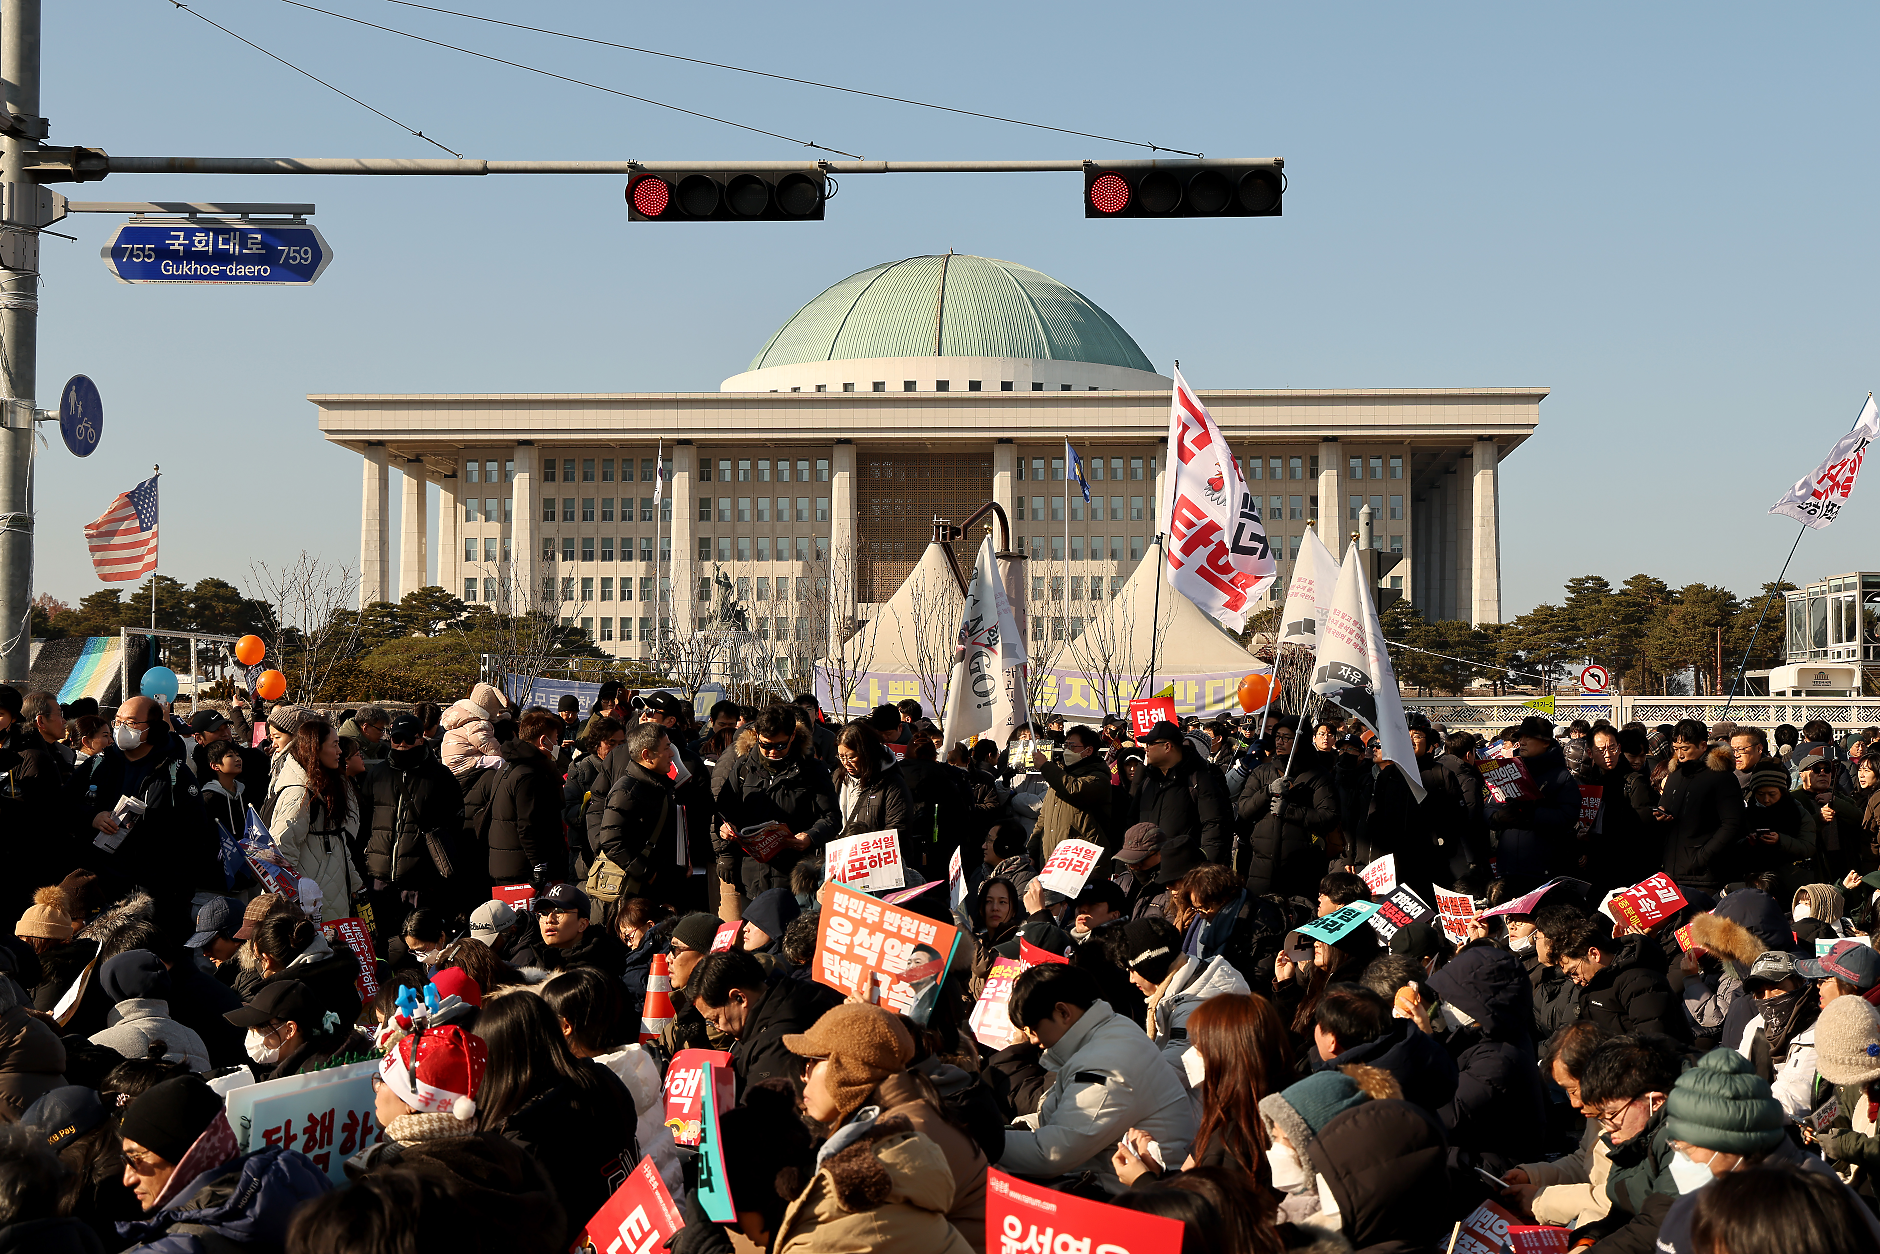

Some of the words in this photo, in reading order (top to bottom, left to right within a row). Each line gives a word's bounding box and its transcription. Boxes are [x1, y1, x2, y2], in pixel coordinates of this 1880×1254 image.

[121, 244, 155, 262] 755
[165, 231, 266, 255] 국회대로
[277, 246, 312, 265] 759
[161, 260, 271, 276] Gukhoe-daero
[1338, 665, 1362, 684] 자유
[860, 834, 895, 855] 윤석열
[1647, 877, 1681, 904] 수괴
[833, 891, 882, 924] 반민주
[882, 910, 938, 945] 반헌법
[825, 915, 916, 975] 윤석열
[822, 951, 863, 993] 탄핵
[47, 1133, 59, 1146] KB
[58, 1125, 76, 1138] Pay
